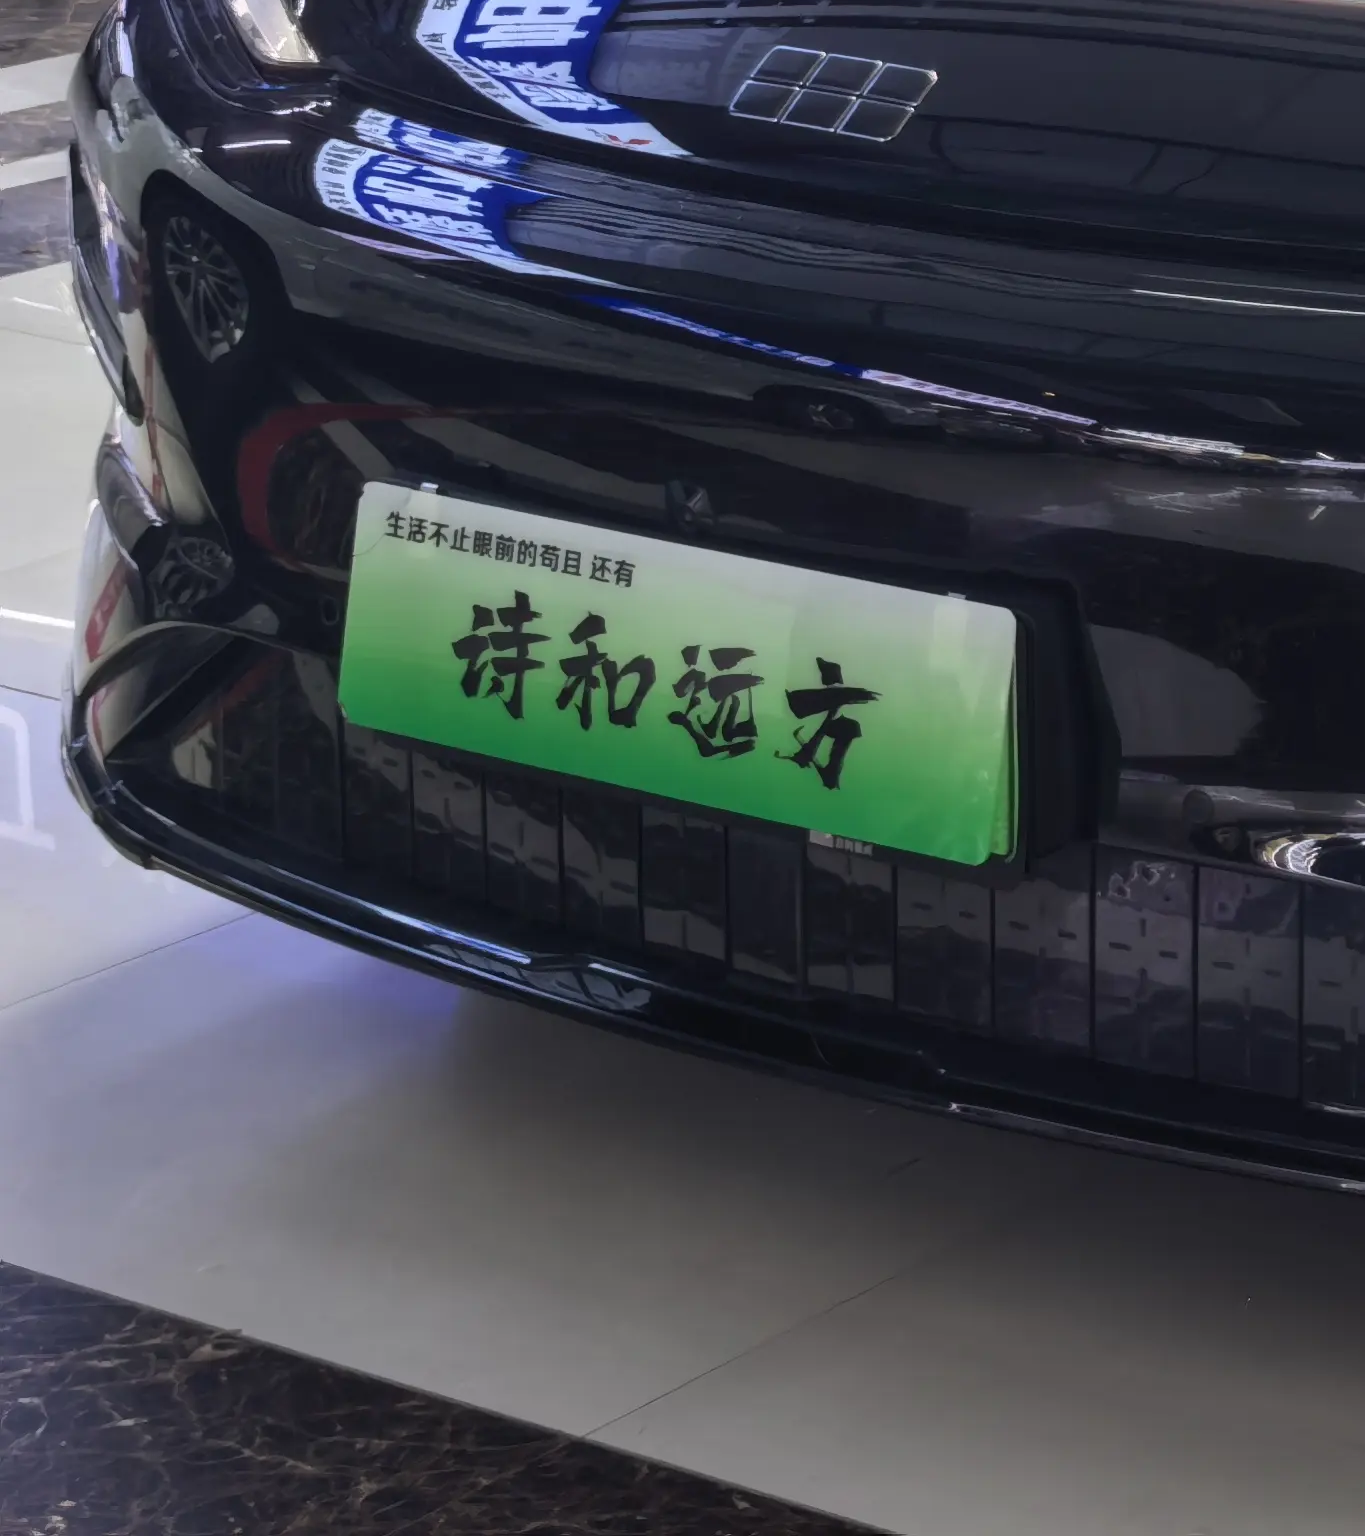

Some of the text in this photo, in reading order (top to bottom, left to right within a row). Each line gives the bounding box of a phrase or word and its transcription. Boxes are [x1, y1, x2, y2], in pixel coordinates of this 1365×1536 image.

[385, 511, 637, 589] 生活不止眼前的苟且 还有
[450, 590, 884, 791] 诗和远方
